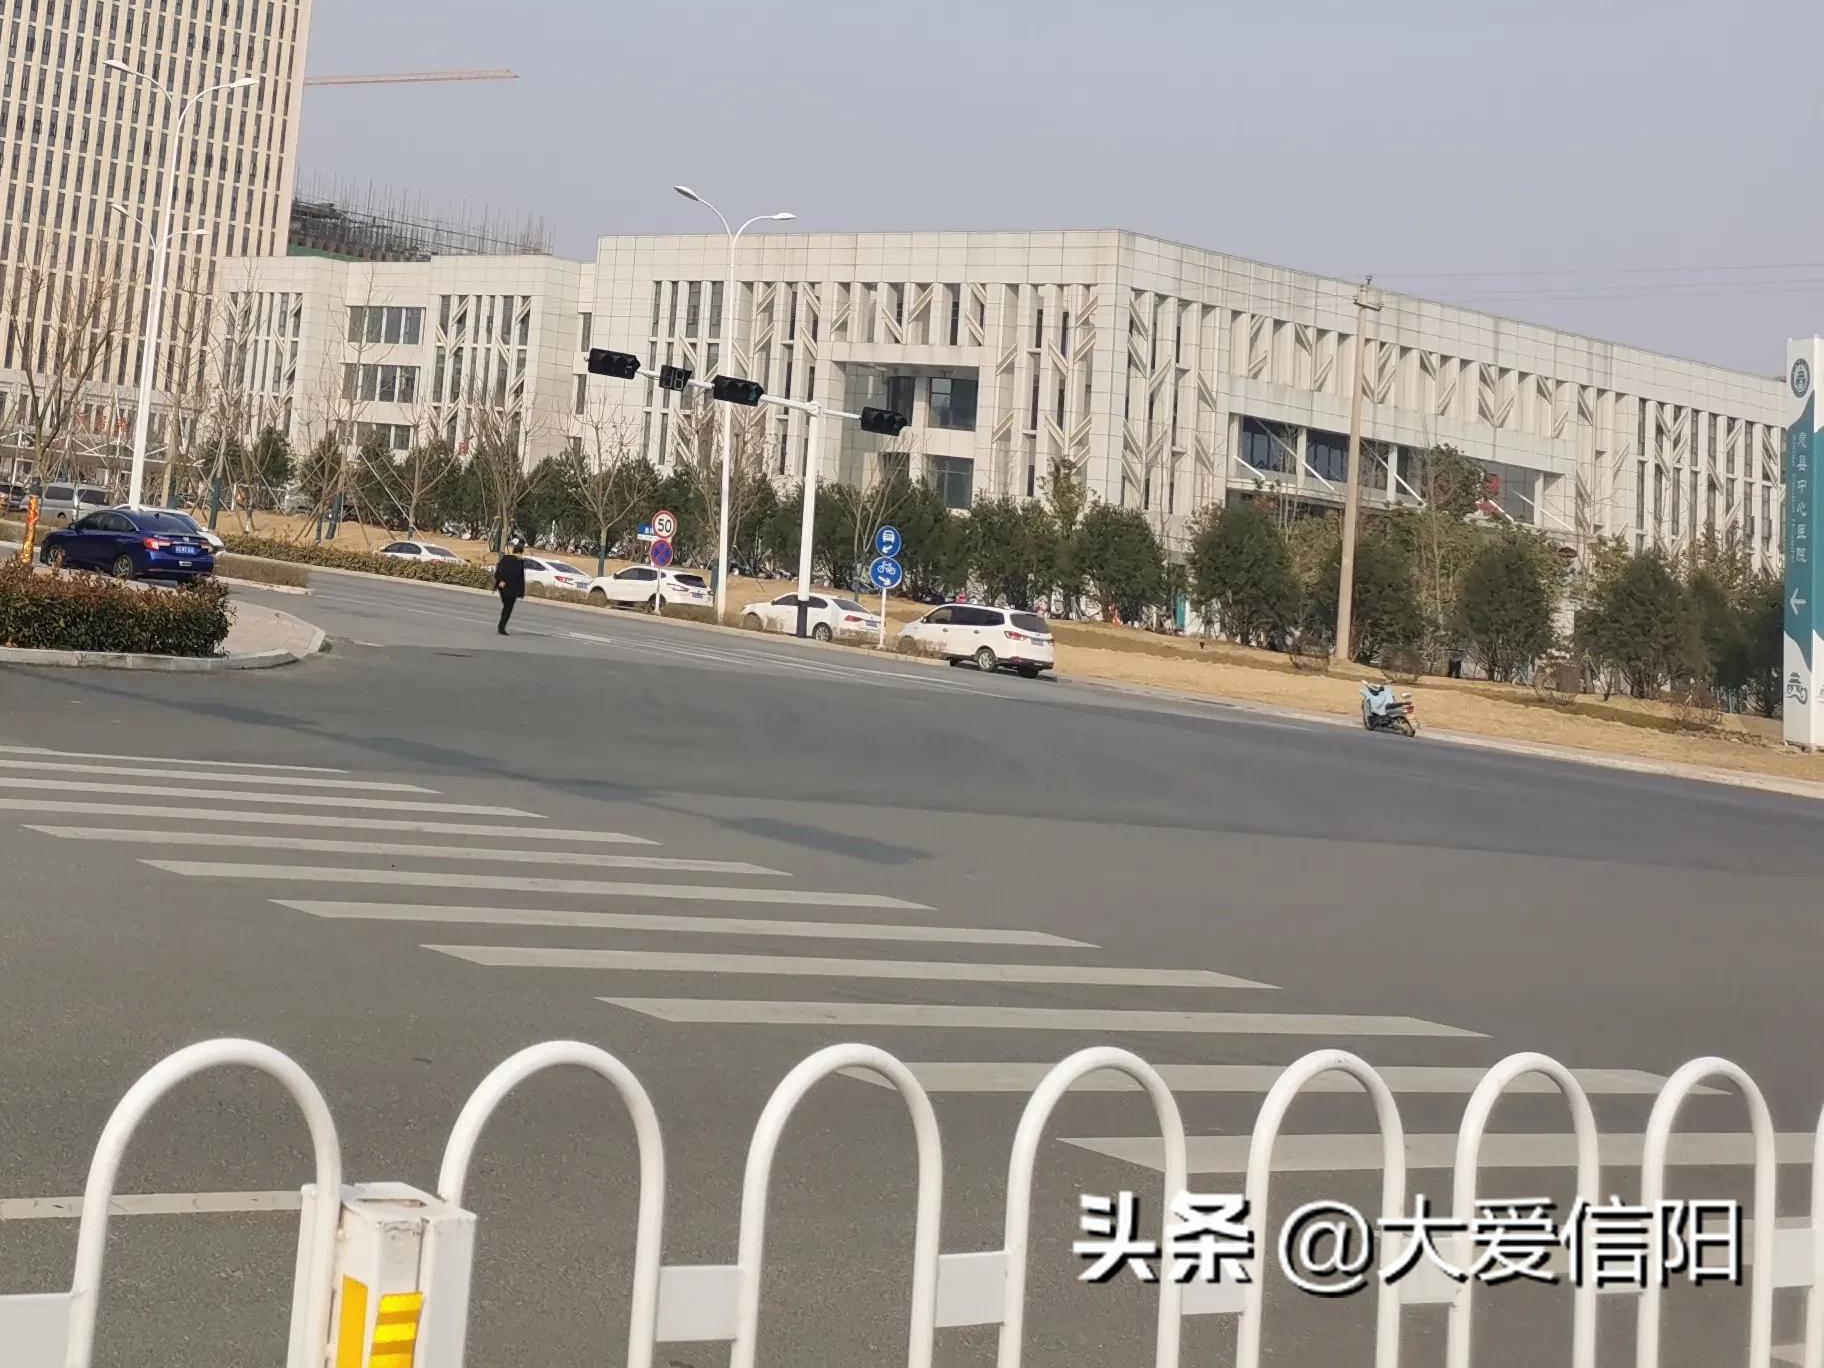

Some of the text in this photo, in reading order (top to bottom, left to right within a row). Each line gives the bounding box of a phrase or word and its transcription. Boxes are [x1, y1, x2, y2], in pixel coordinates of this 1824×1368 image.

[657, 518, 672, 534] 50
[1796, 431, 1808, 564] 息县中心医院
